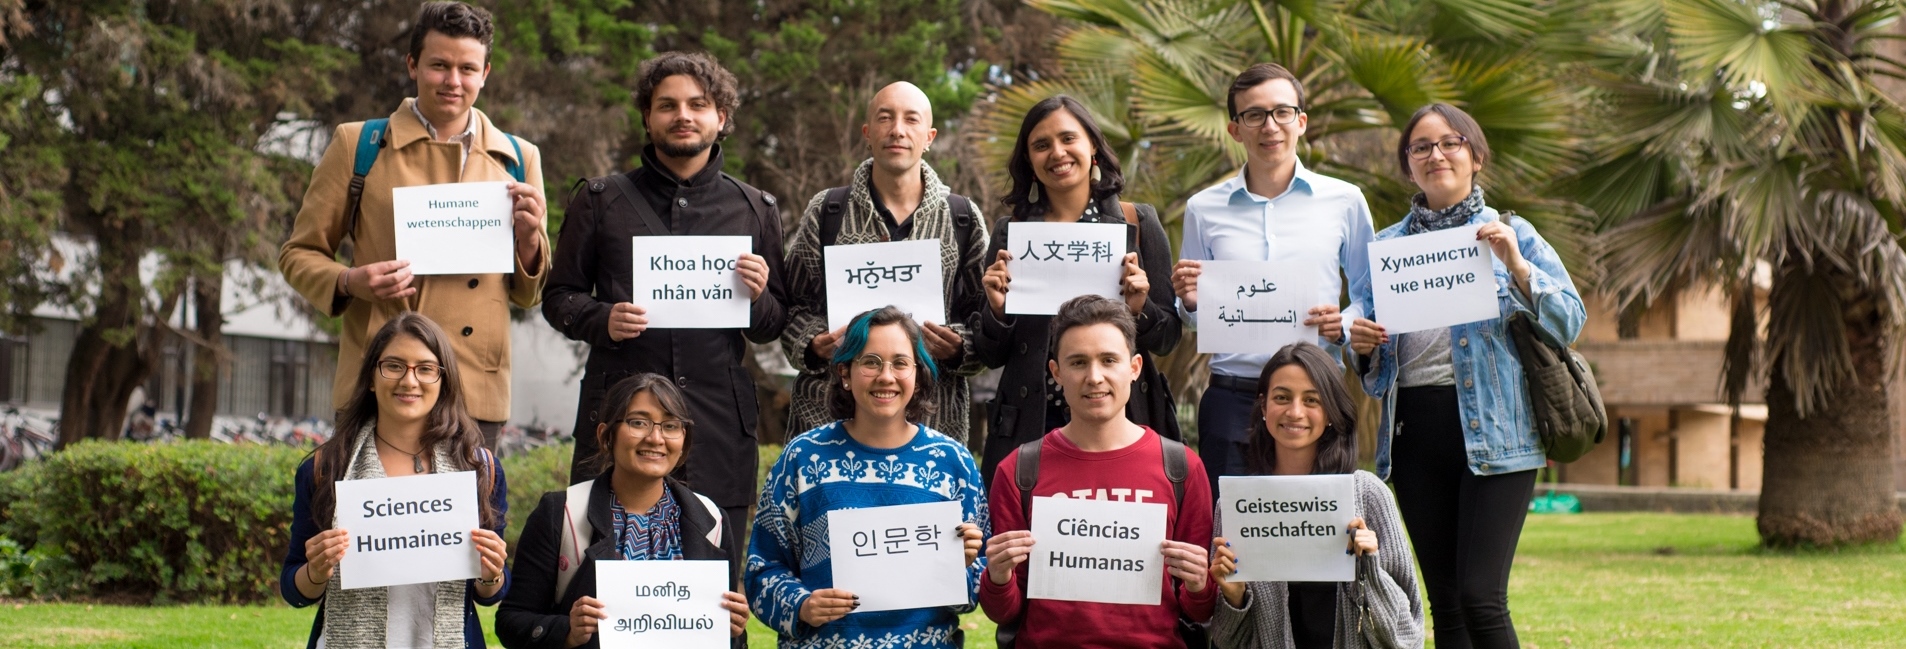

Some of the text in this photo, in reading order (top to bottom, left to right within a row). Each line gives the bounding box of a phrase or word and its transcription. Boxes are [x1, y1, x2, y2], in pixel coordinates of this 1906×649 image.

[428, 199, 479, 210] Humane
[406, 216, 502, 231] wetenschappen
[1019, 240, 1114, 263] 人文学科
[1380, 245, 1480, 273] Хуманисти
[650, 254, 736, 275] Khoa học
[845, 261, 922, 289] ਮਨੁੱਖਤਾ
[652, 283, 733, 300] nhân văn
[1390, 269, 1476, 295] чке науке
[362, 496, 453, 519] Sciences
[1235, 496, 1338, 514] Geisteswiss
[1057, 518, 1140, 540] Ciências
[1240, 520, 1336, 539] enschaften
[356, 529, 463, 553] Humaines
[852, 524, 942, 558] 인문학
[1049, 551, 1145, 572] Humanas
[635, 581, 691, 602] மனித
[613, 613, 714, 635] அறிவியல்
